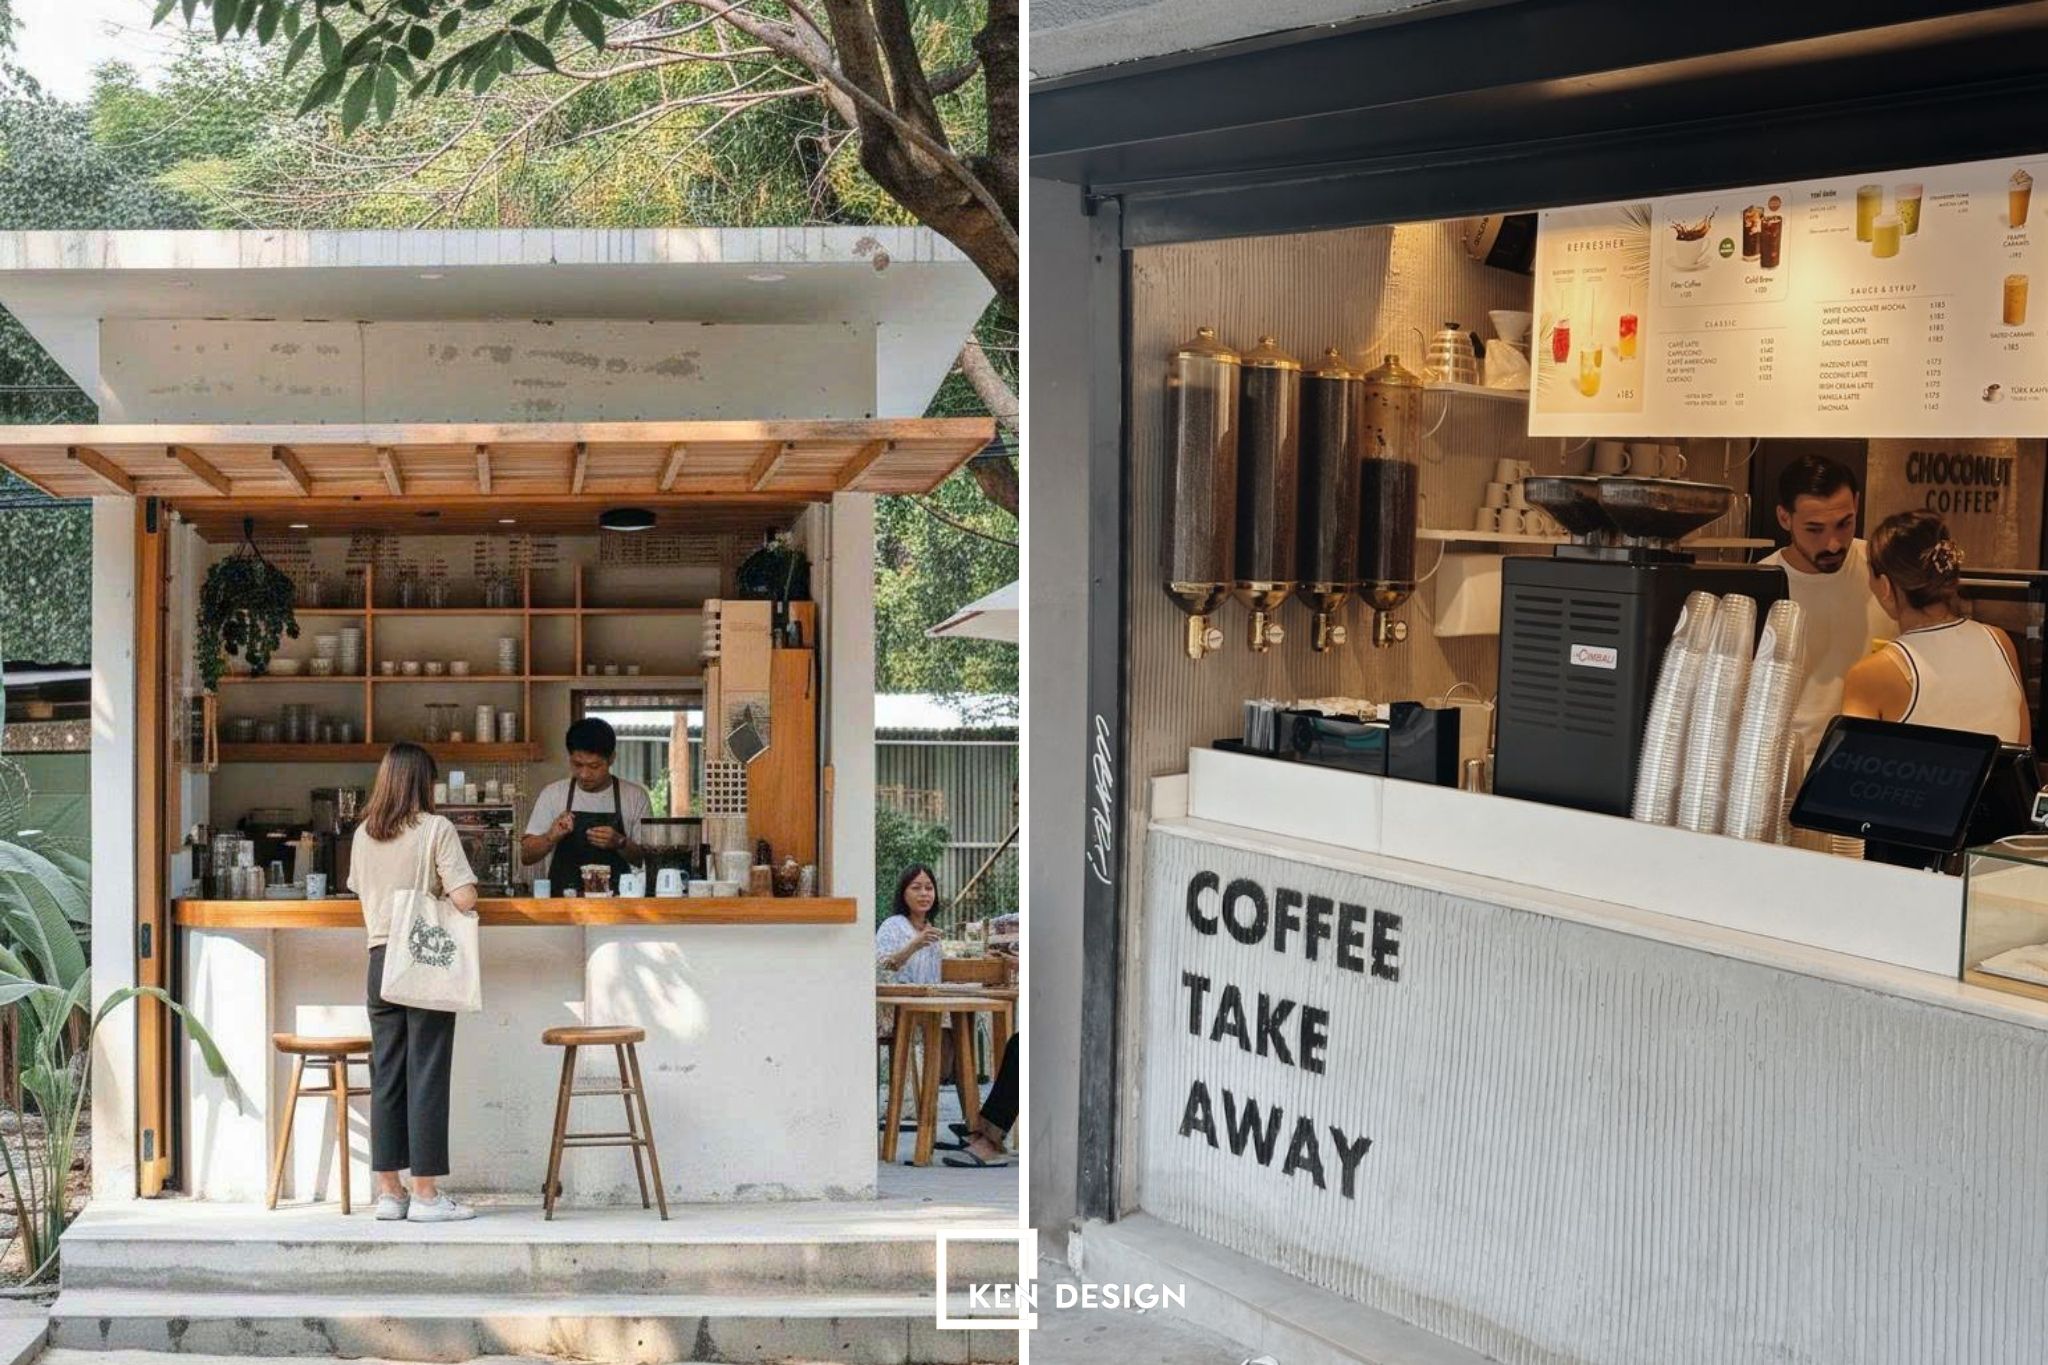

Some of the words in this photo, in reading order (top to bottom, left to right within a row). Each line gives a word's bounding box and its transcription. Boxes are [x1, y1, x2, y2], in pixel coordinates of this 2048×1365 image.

[1567, 239, 1625, 252] REFRESHER
[1745, 276, 1759, 284] Cold
[1889, 284, 1917, 292] SYRUP
[1843, 305, 1879, 313] CHOCOLATE
[1705, 320, 1737, 328] CLASSIC
[1906, 452, 2013, 487] CHOCONUT
[1926, 490, 1993, 514] COFFEE
[1831, 751, 1970, 788] CHOCONUT
[1849, 780, 1929, 808] COFFEE
[1186, 870, 1403, 983] COFFEE
[1182, 970, 1330, 1075] TAKE
[1178, 1080, 1373, 1200] AWAY
